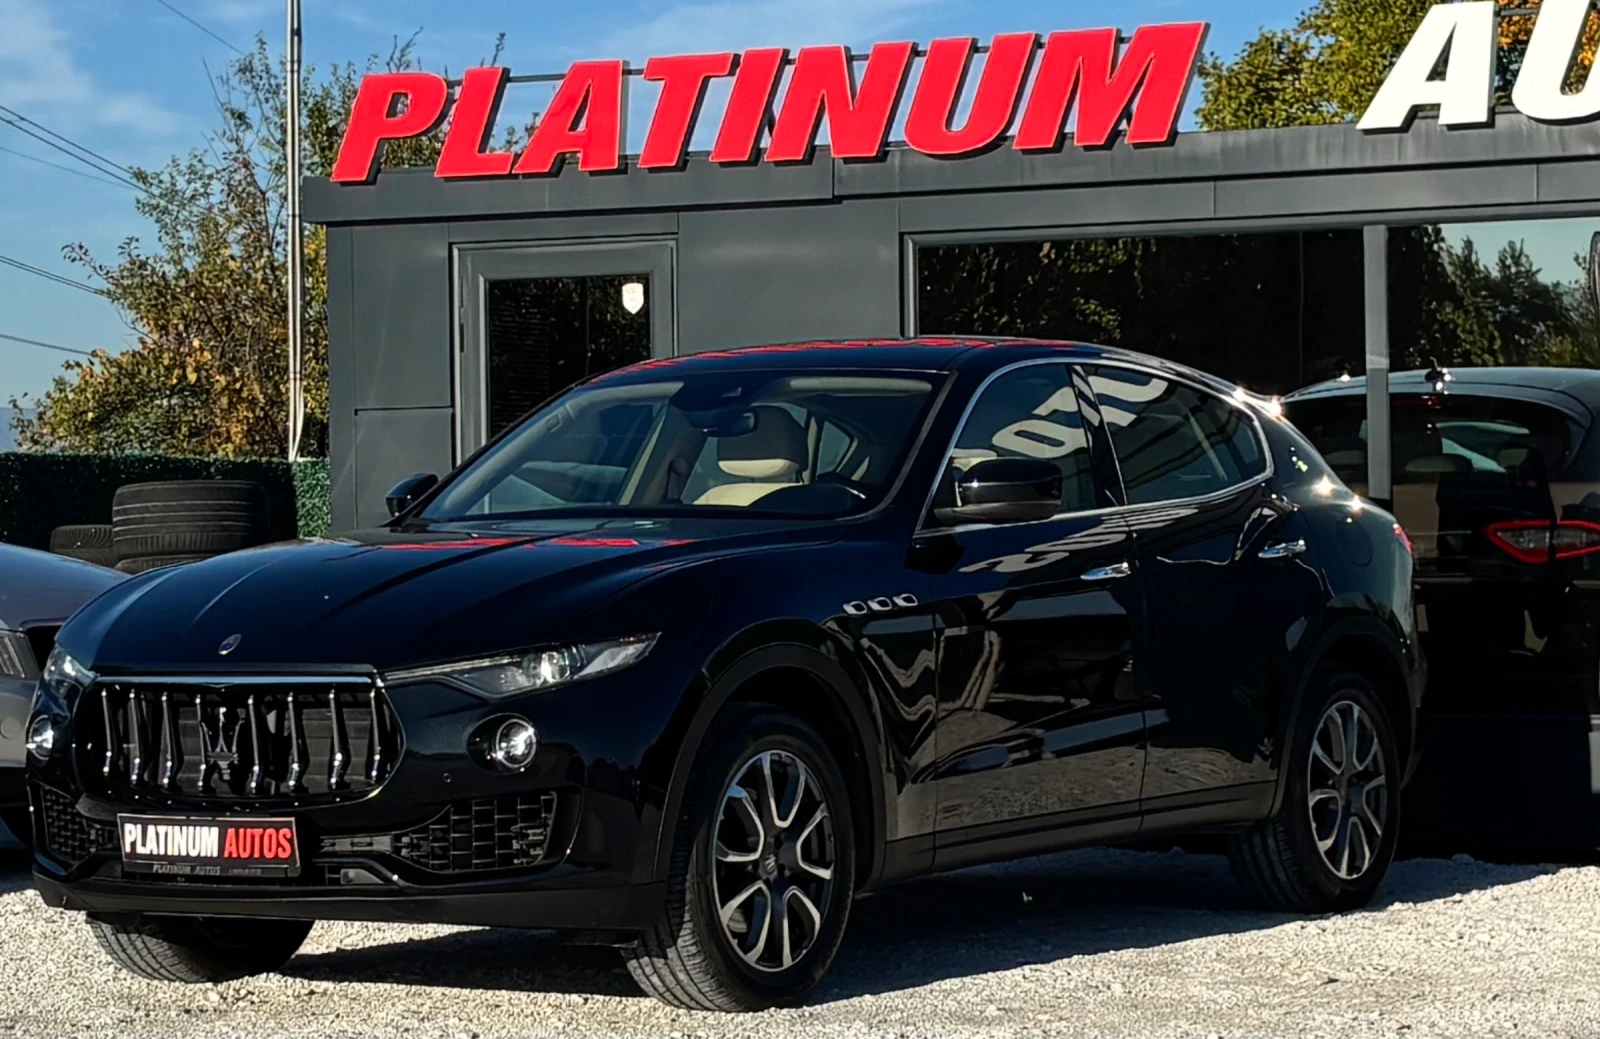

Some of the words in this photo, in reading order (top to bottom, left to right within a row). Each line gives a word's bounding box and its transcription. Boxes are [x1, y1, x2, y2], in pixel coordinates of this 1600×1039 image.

[331, 21, 1207, 183] PLATINUM
[123, 822, 219, 858] PLATINUM
[223, 827, 292, 859] AUTOS
